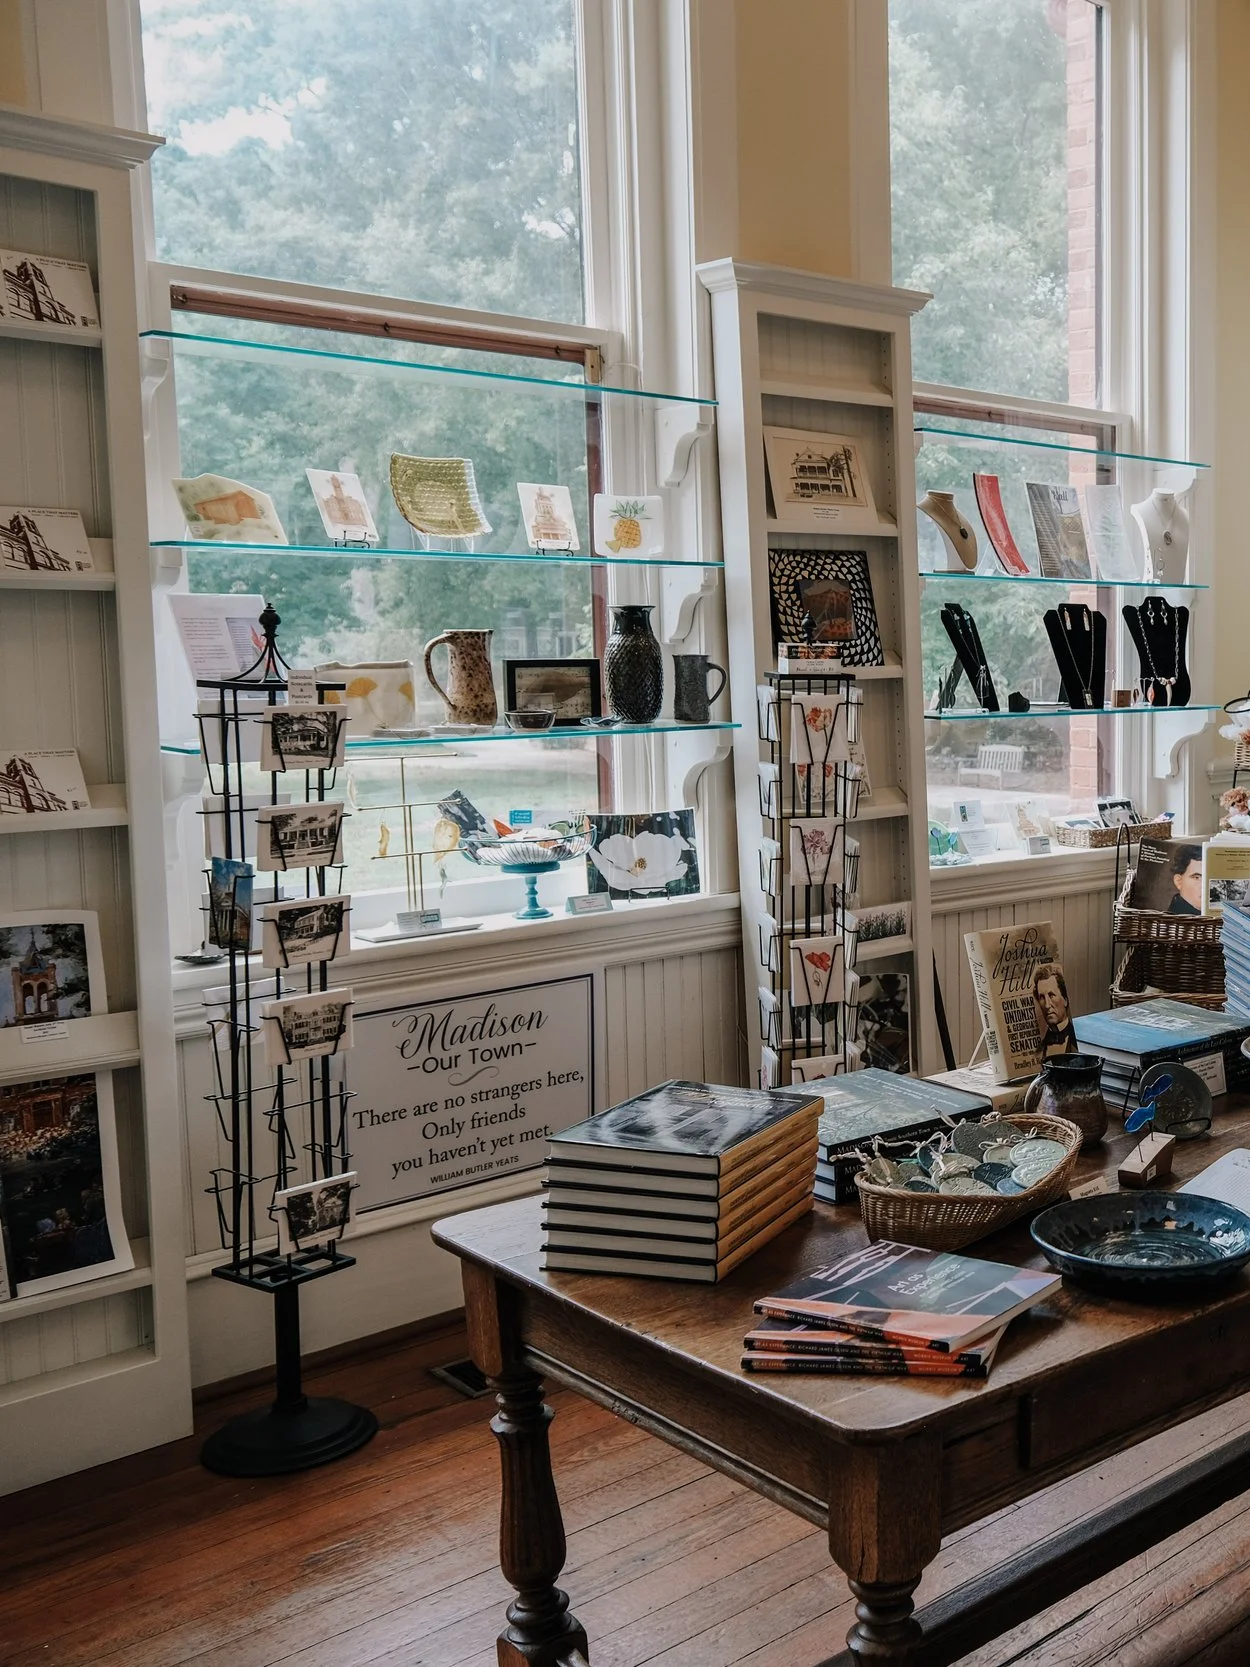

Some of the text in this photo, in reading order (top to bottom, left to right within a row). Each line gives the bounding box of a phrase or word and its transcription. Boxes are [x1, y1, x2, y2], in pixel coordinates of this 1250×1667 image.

[993, 928, 1048, 979] Joshua
[999, 960, 1037, 996] Hill
[1002, 996, 1035, 1011] CIVIL WAR
[1003, 1009, 1037, 1025] UNIONIST
[1007, 1025, 1012, 1033] &
[392, 1002, 548, 1060] Madison
[1008, 1029, 1041, 1042] FIRST REPUBLICAN
[467, 1042, 523, 1065] Town
[1010, 1037, 1042, 1053] SENATOR
[1014, 1059, 1032, 1070] Bradley
[352, 1069, 585, 1130] There are no strangers here,
[422, 1104, 526, 1141] Only friends
[391, 1123, 554, 1179] you haven't yet met.
[430, 1155, 519, 1184] WILLIAM BUTLER YEATS
[888, 1273, 924, 1292] Art as
[899, 1263, 961, 1295] Experience
